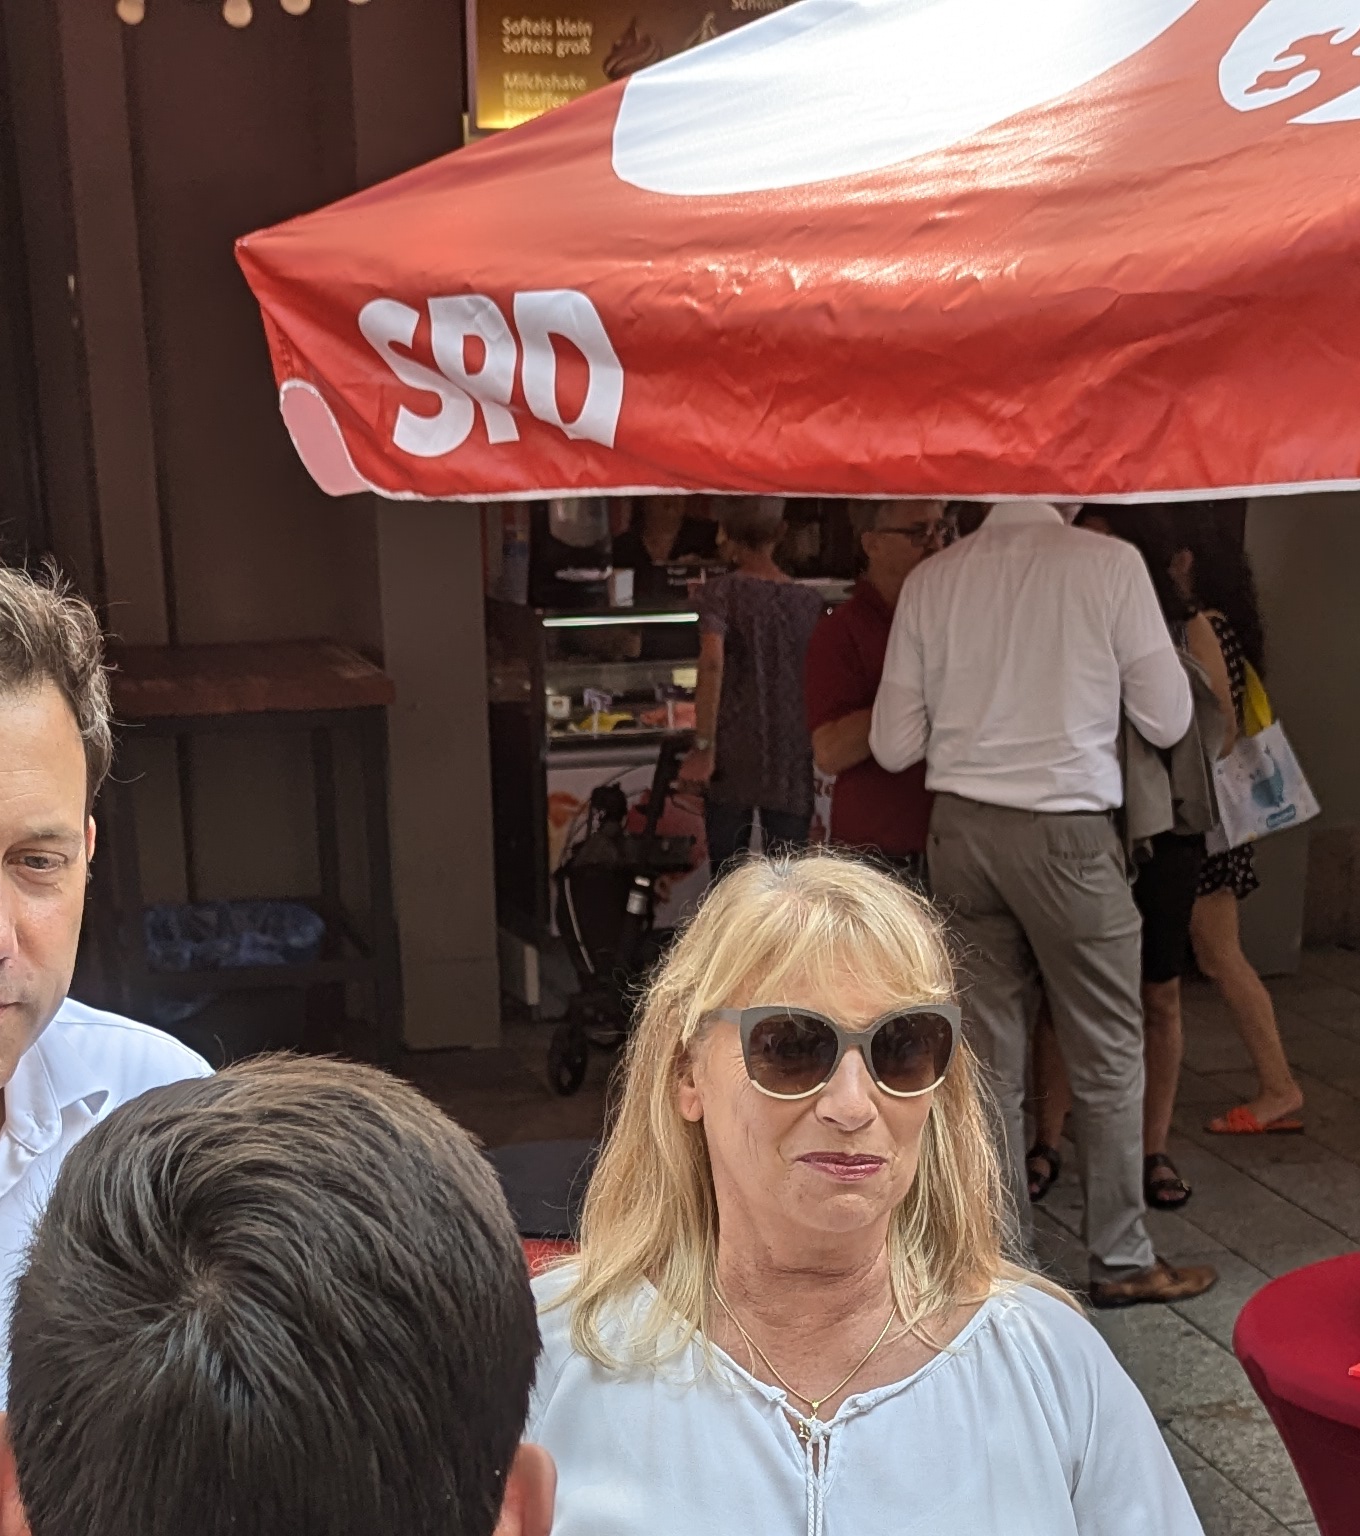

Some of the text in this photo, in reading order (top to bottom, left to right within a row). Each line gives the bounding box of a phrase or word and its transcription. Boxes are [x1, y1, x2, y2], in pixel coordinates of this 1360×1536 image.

[502, 17, 592, 37] Softeis klein
[502, 37, 591, 58] Softeis groß
[504, 73, 587, 91] Milchshake
[358, 289, 624, 457] SPD
